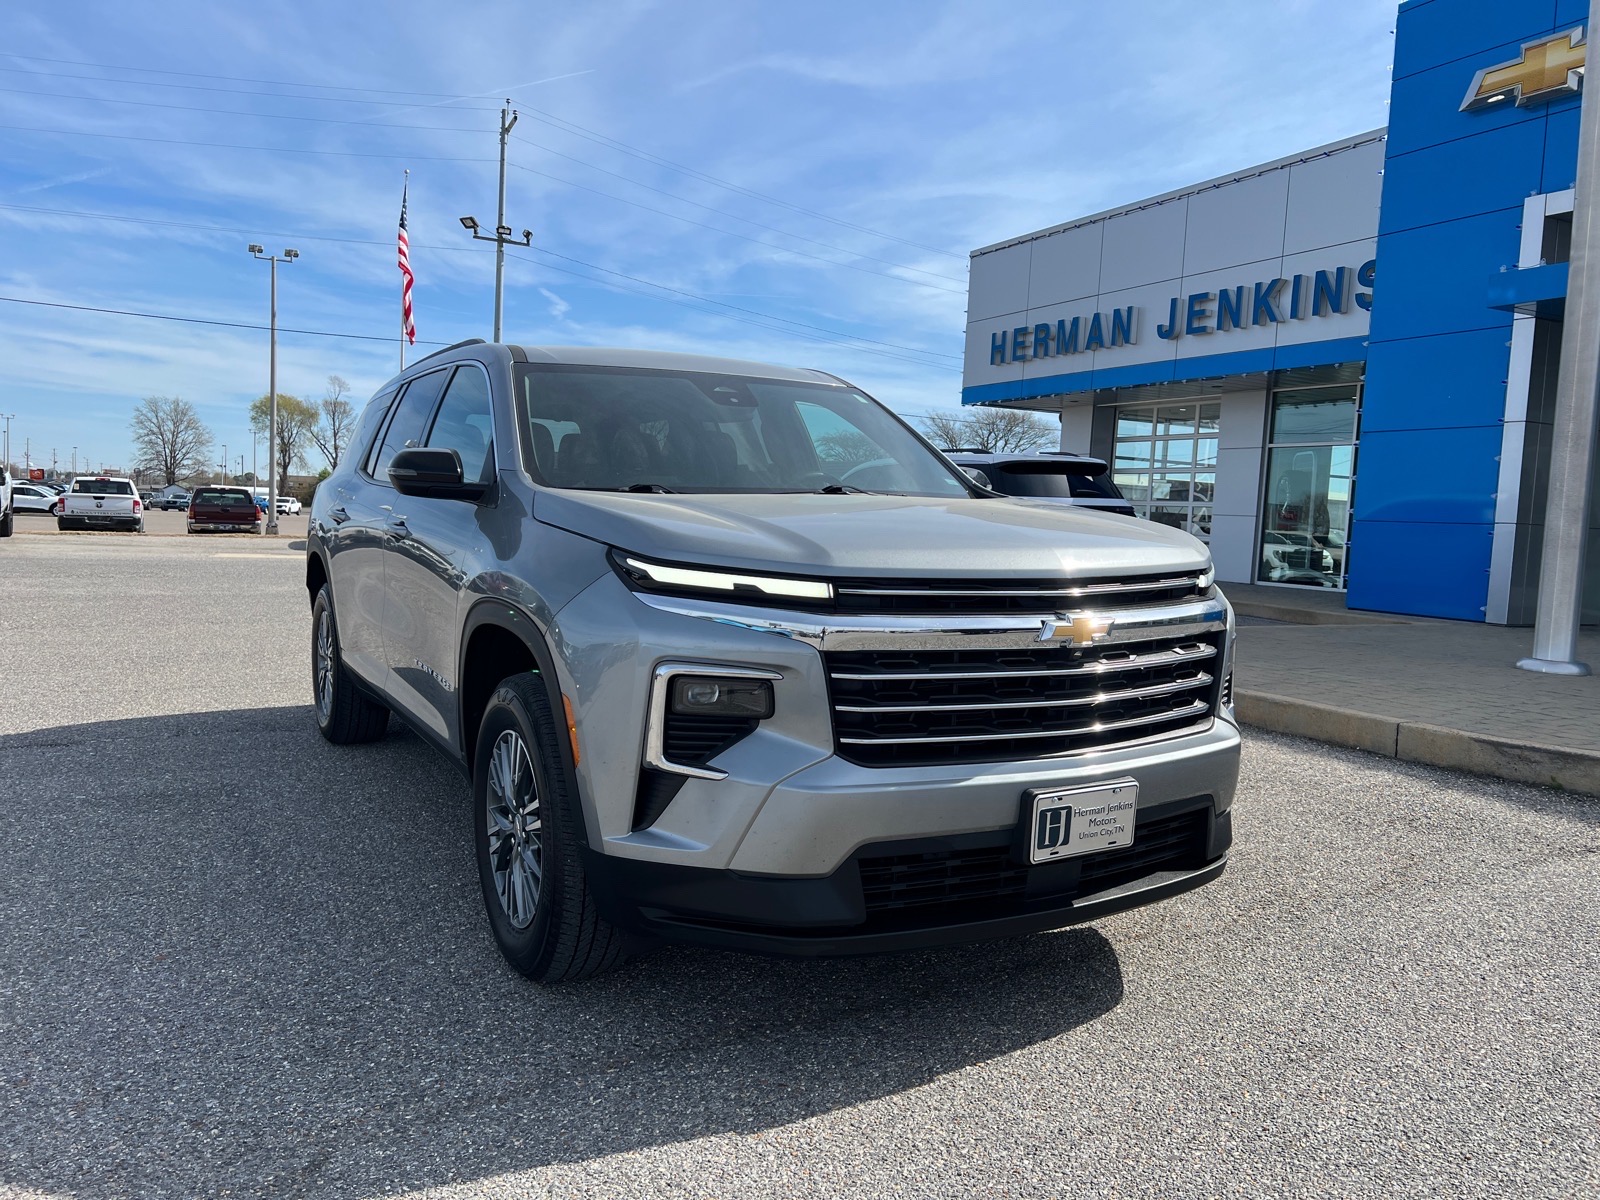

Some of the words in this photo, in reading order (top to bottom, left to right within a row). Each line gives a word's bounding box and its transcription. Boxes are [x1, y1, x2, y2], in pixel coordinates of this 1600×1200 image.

[990, 305, 1138, 365] HERMAN
[1156, 258, 1375, 340] JENKINS
[1073, 806, 1106, 818] Herman
[1106, 801, 1133, 815] Jenkins
[1088, 816, 1117, 828] Motors
[1078, 829, 1099, 840] Union
